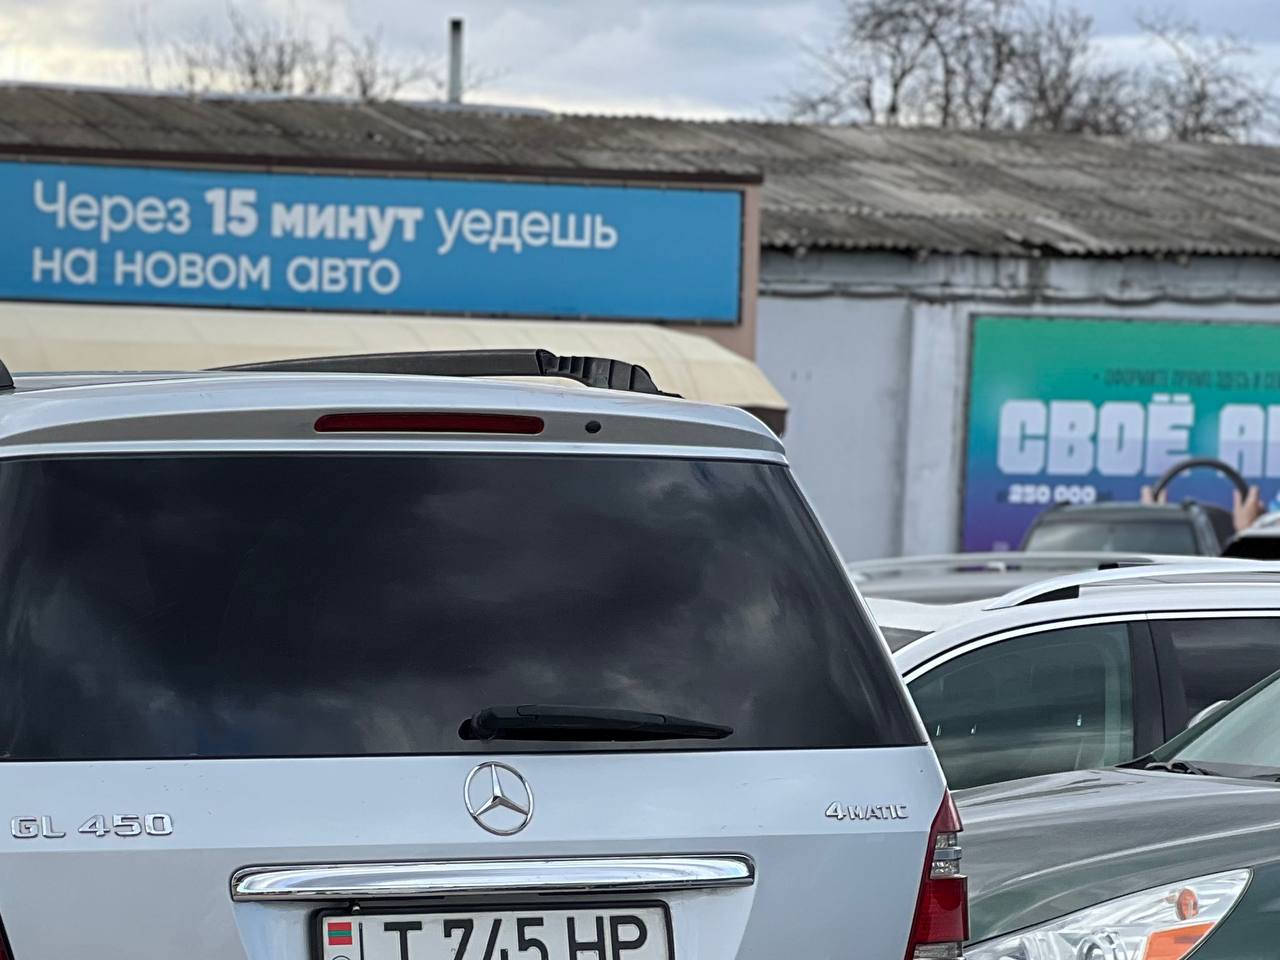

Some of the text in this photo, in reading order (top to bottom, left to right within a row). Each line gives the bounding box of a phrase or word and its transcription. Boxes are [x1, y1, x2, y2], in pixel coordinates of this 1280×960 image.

[33, 179, 618, 254] Через 15 минут уедешь
[32, 246, 401, 294] на новом авто
[997, 393, 1195, 477] СВОЁ
[10, 813, 174, 839] GL 450
[825, 801, 909, 821] 4MATIC
